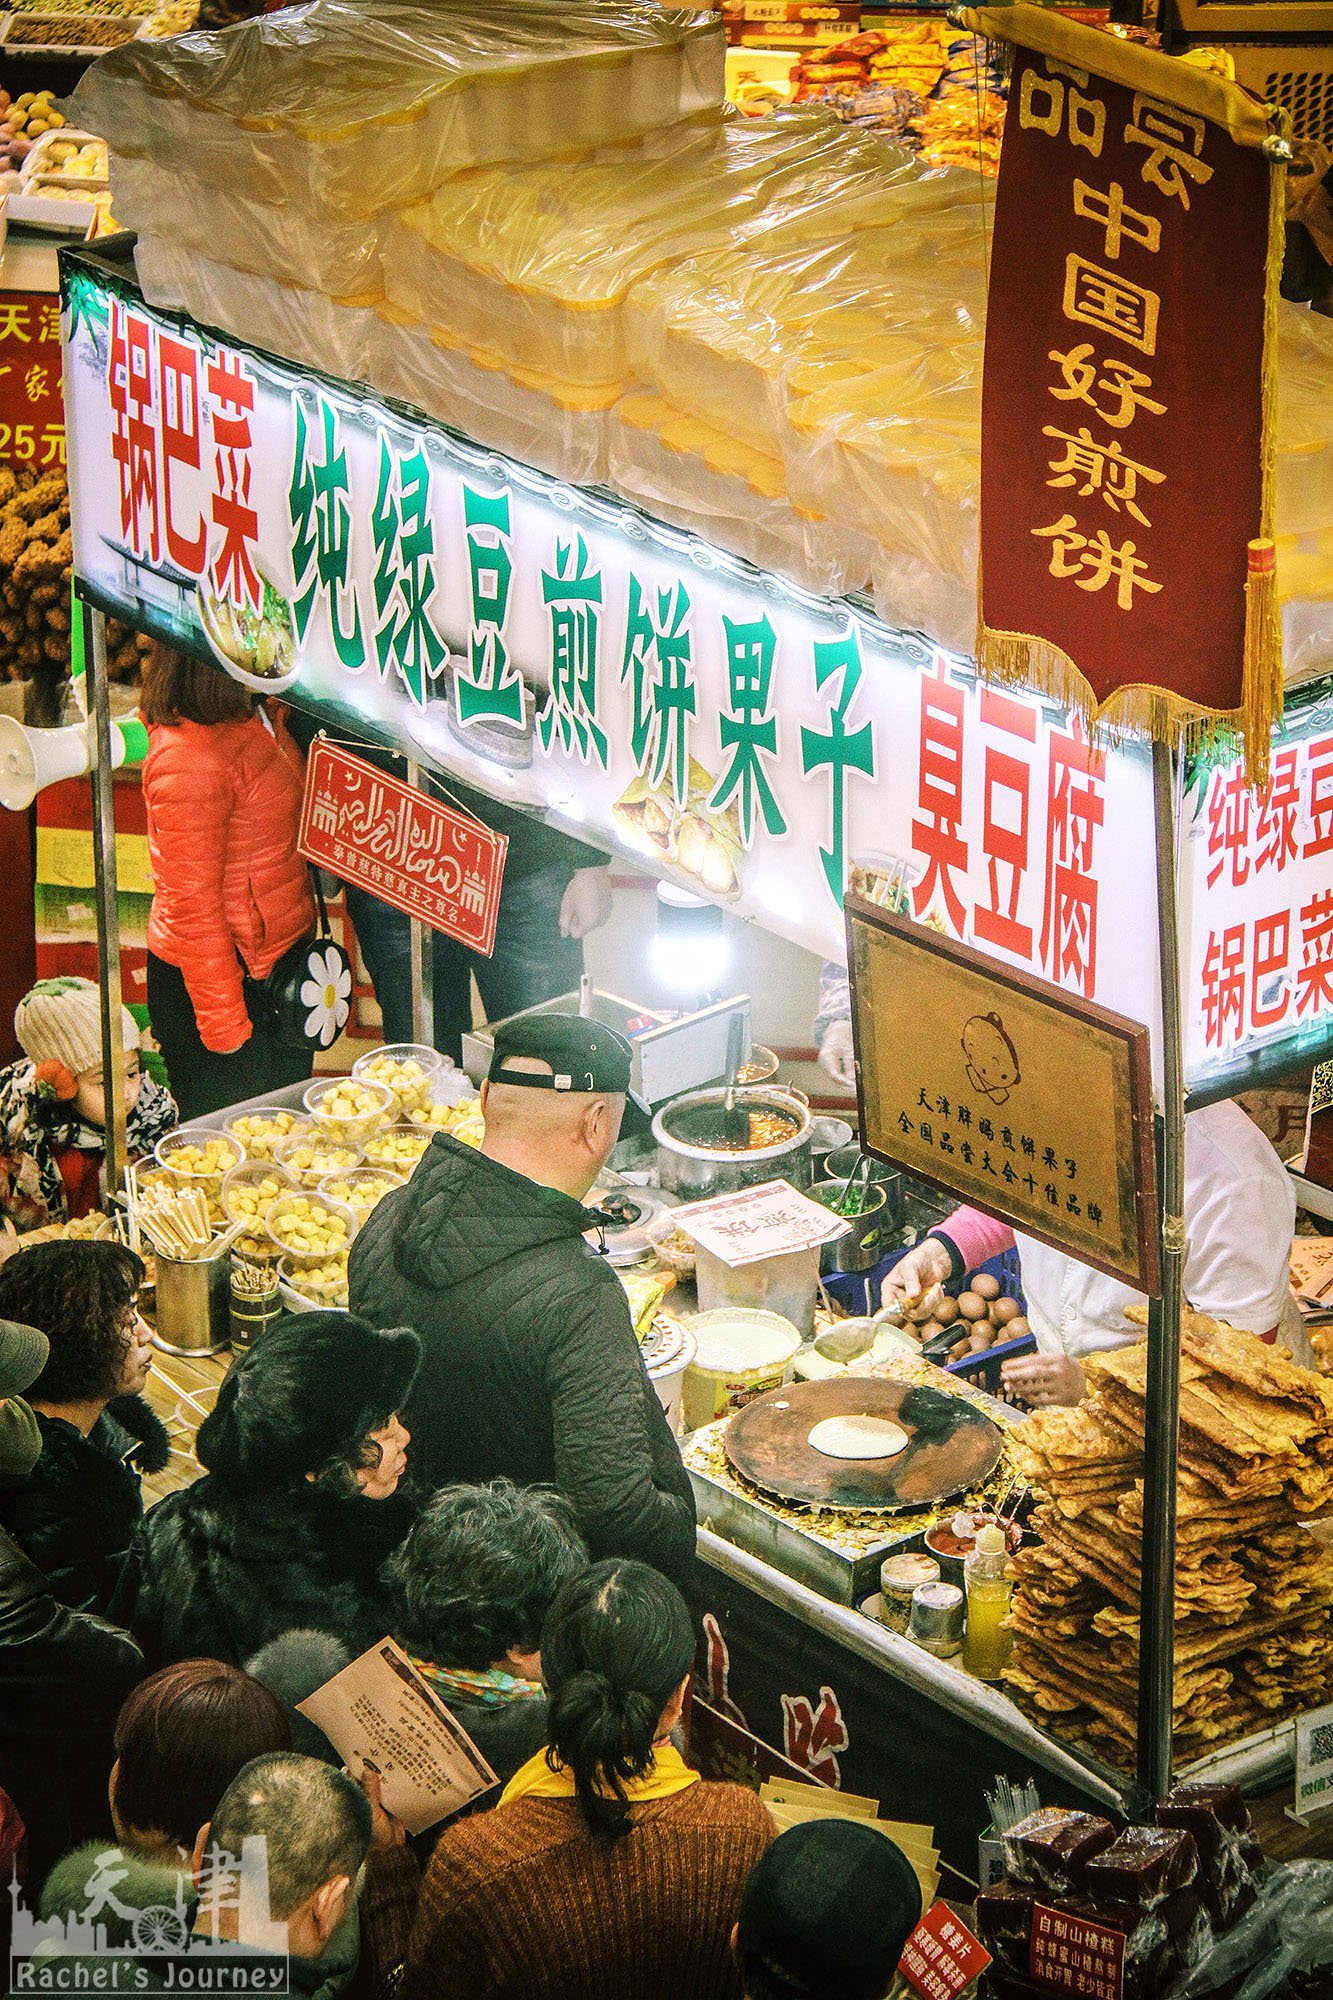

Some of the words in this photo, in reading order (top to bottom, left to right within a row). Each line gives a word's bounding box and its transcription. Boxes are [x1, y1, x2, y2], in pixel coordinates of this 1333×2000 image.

[108, 299, 261, 614] 锅巴菜
[1030, 177, 1168, 611] 中国好煎饼
[288, 392, 874, 907] 纯绿豆煎饼果子
[910, 649, 1107, 1000] 臭豆腐
[1039, 1913, 1115, 1956] 自制山楂糕
